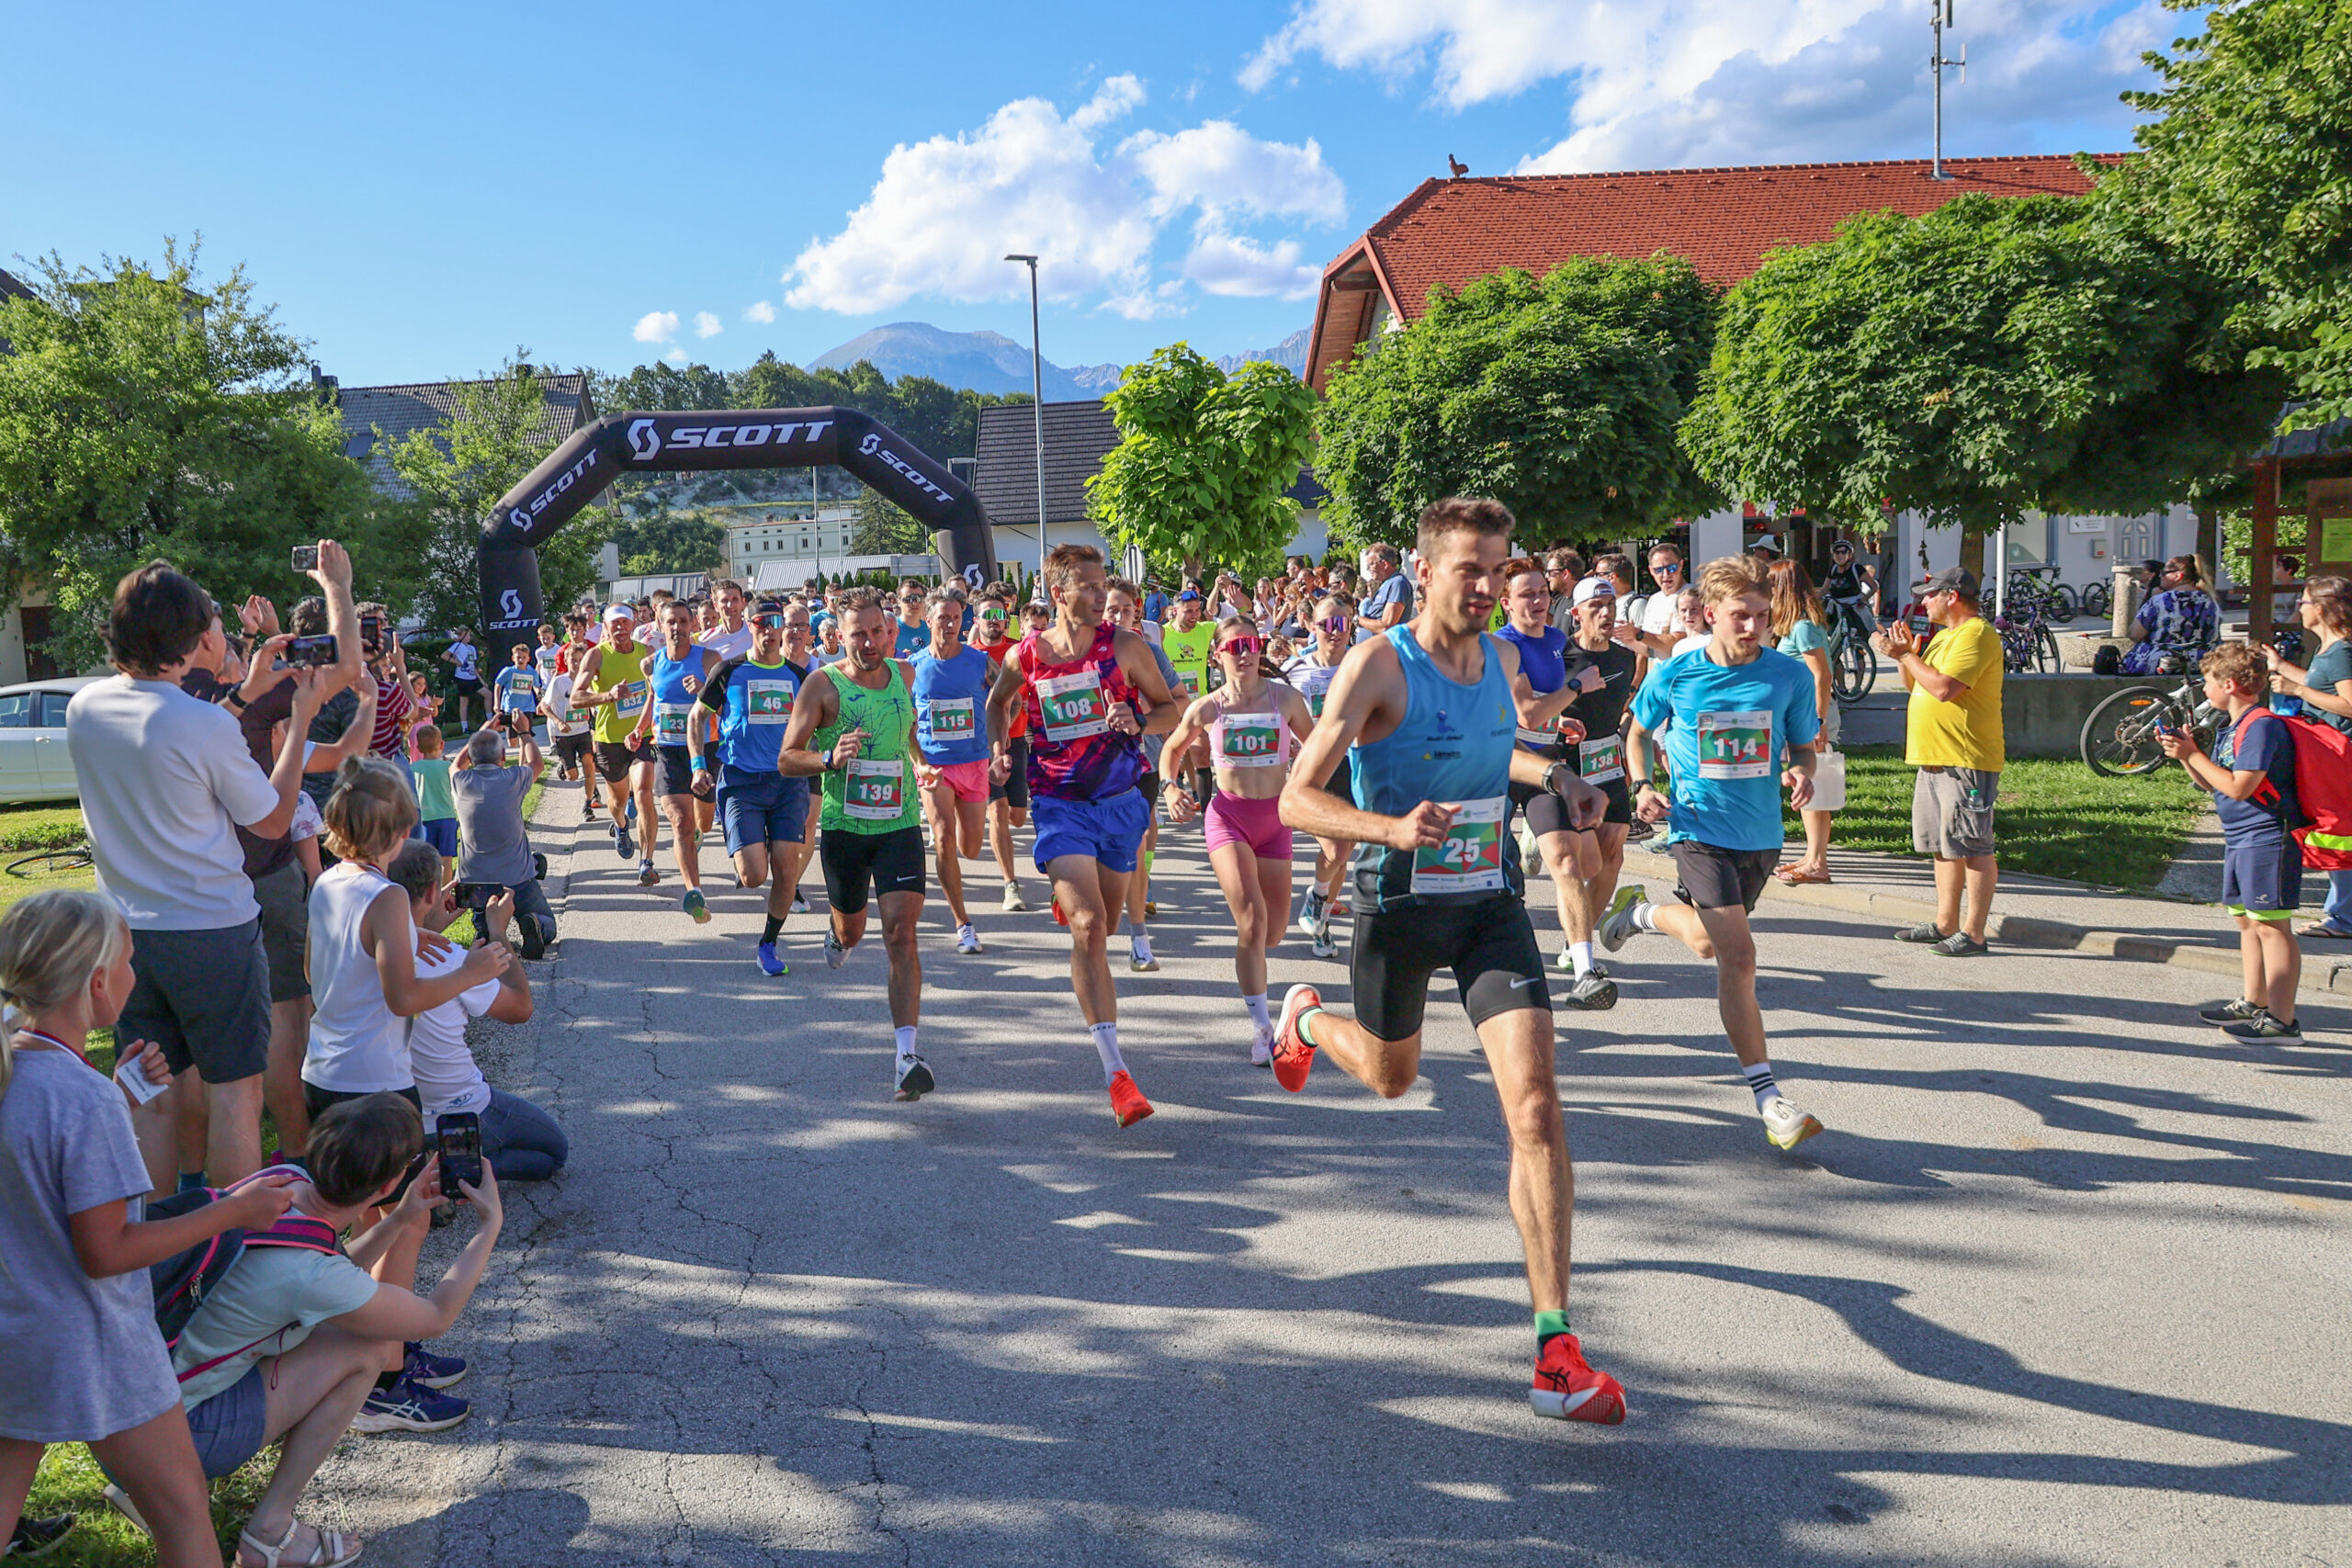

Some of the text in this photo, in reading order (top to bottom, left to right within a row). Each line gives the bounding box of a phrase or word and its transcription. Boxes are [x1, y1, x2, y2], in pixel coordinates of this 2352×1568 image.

[664, 420, 834, 449] SCOTT
[530, 447, 597, 516] SCOTT
[876, 449, 955, 502] SCOTT
[489, 618, 539, 630] SCOTT
[623, 695, 643, 708] 832
[763, 696, 782, 710] 46
[1053, 697, 1092, 720] 108
[572, 712, 582, 722] 91
[669, 718, 685, 730] 23
[940, 715, 966, 728] 115
[1234, 735, 1267, 750] 101
[1713, 738, 1758, 757] 114
[1590, 752, 1614, 770] 138
[858, 783, 893, 801] 139
[1444, 837, 1481, 863] 25
